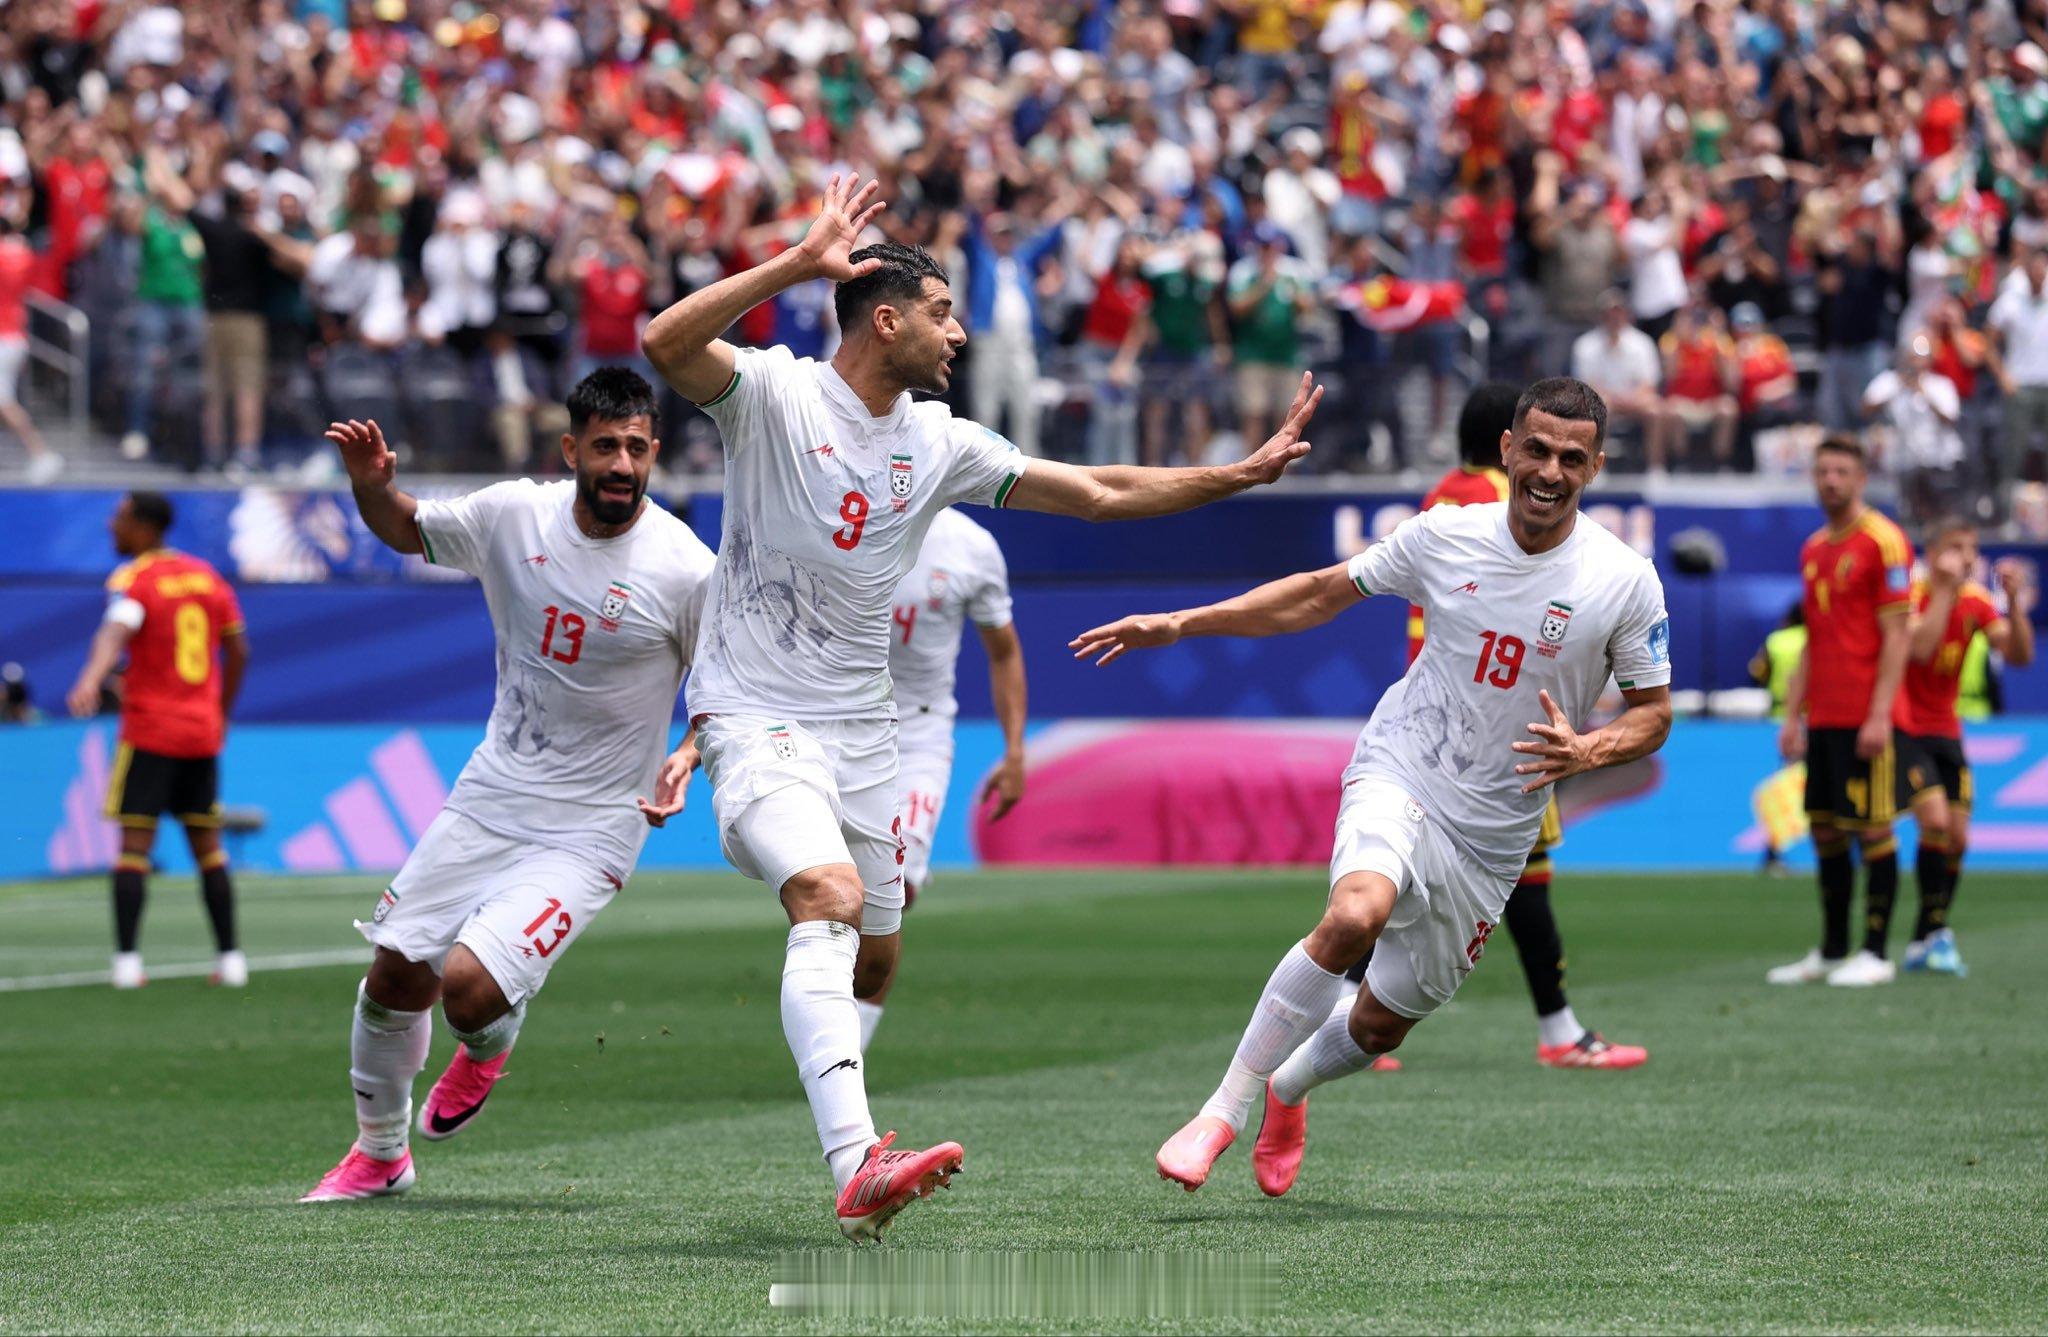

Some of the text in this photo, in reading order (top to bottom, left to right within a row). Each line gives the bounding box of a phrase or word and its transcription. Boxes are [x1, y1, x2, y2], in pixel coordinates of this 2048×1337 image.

[832, 490, 870, 551] 9
[174, 602, 210, 685] 8
[543, 605, 586, 665] 13
[1473, 629, 1526, 690] 19
[523, 898, 572, 957] 13
